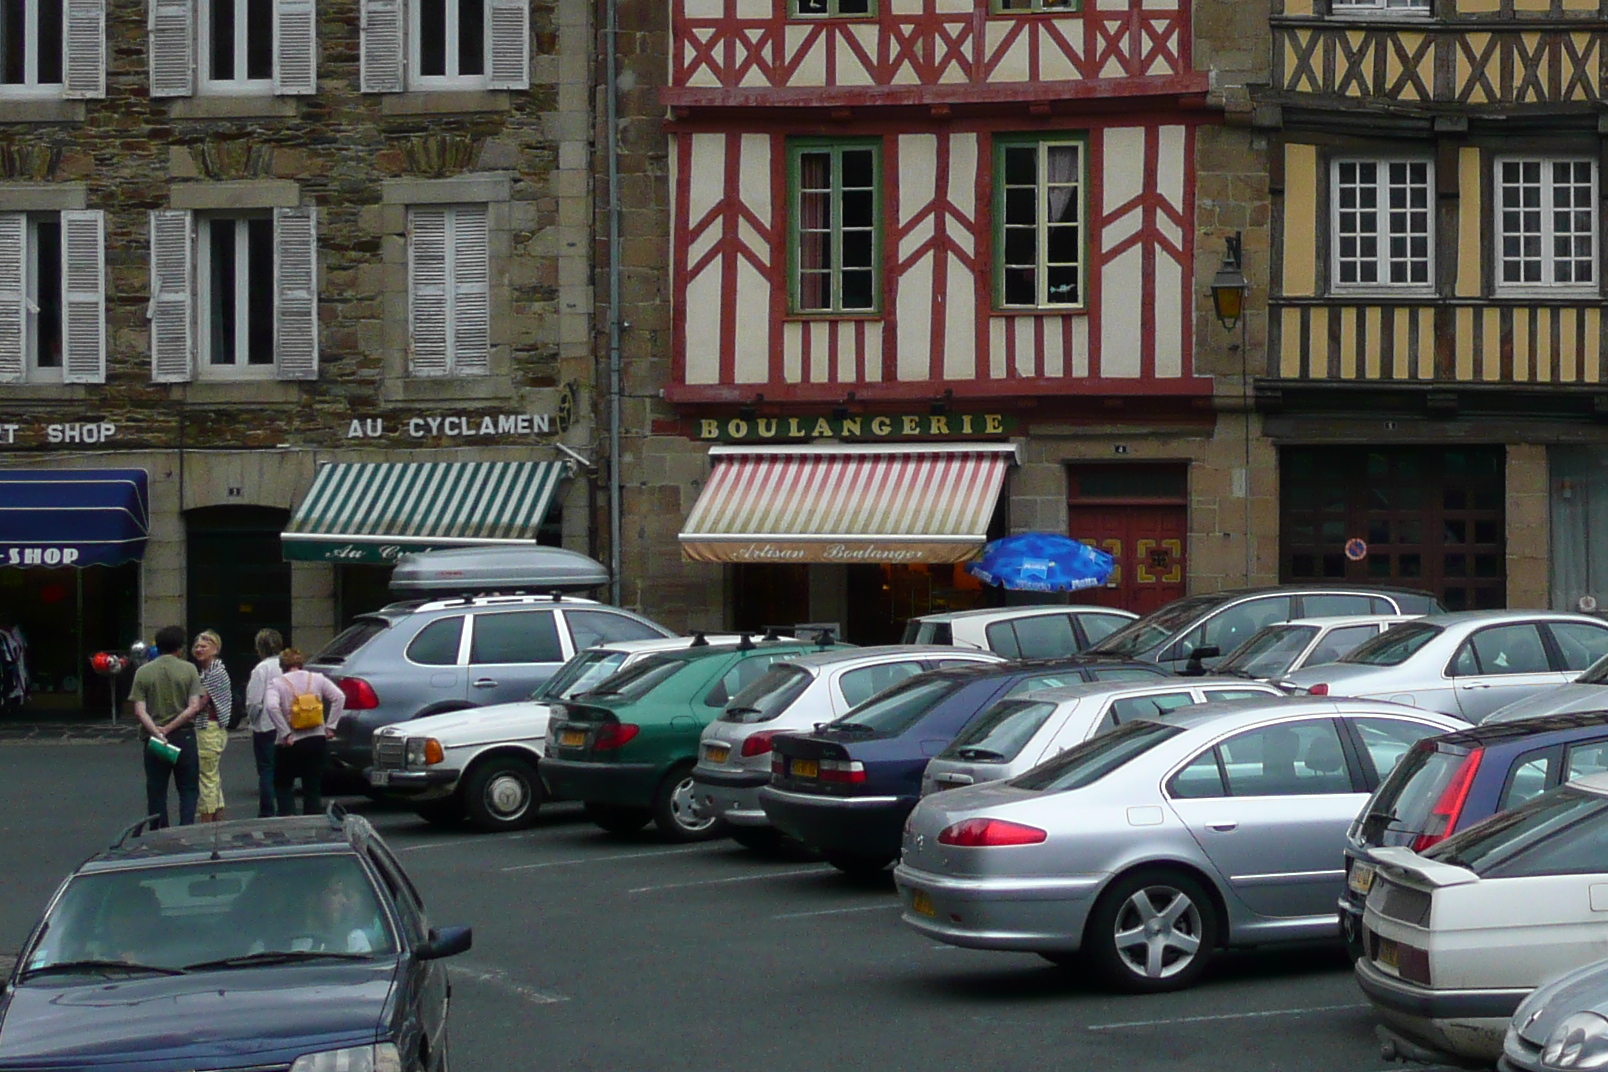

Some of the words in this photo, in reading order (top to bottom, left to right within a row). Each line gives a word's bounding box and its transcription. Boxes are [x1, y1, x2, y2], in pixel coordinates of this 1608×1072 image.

[47, 423, 116, 443] SHOP
[348, 418, 383, 438] AU
[409, 414, 549, 438] CYCLAMEN
[700, 414, 1004, 439] BOULANGERIE
[324, 544, 367, 558] Au
[732, 544, 805, 560] Artisan
[822, 543, 923, 563] Boulanger
